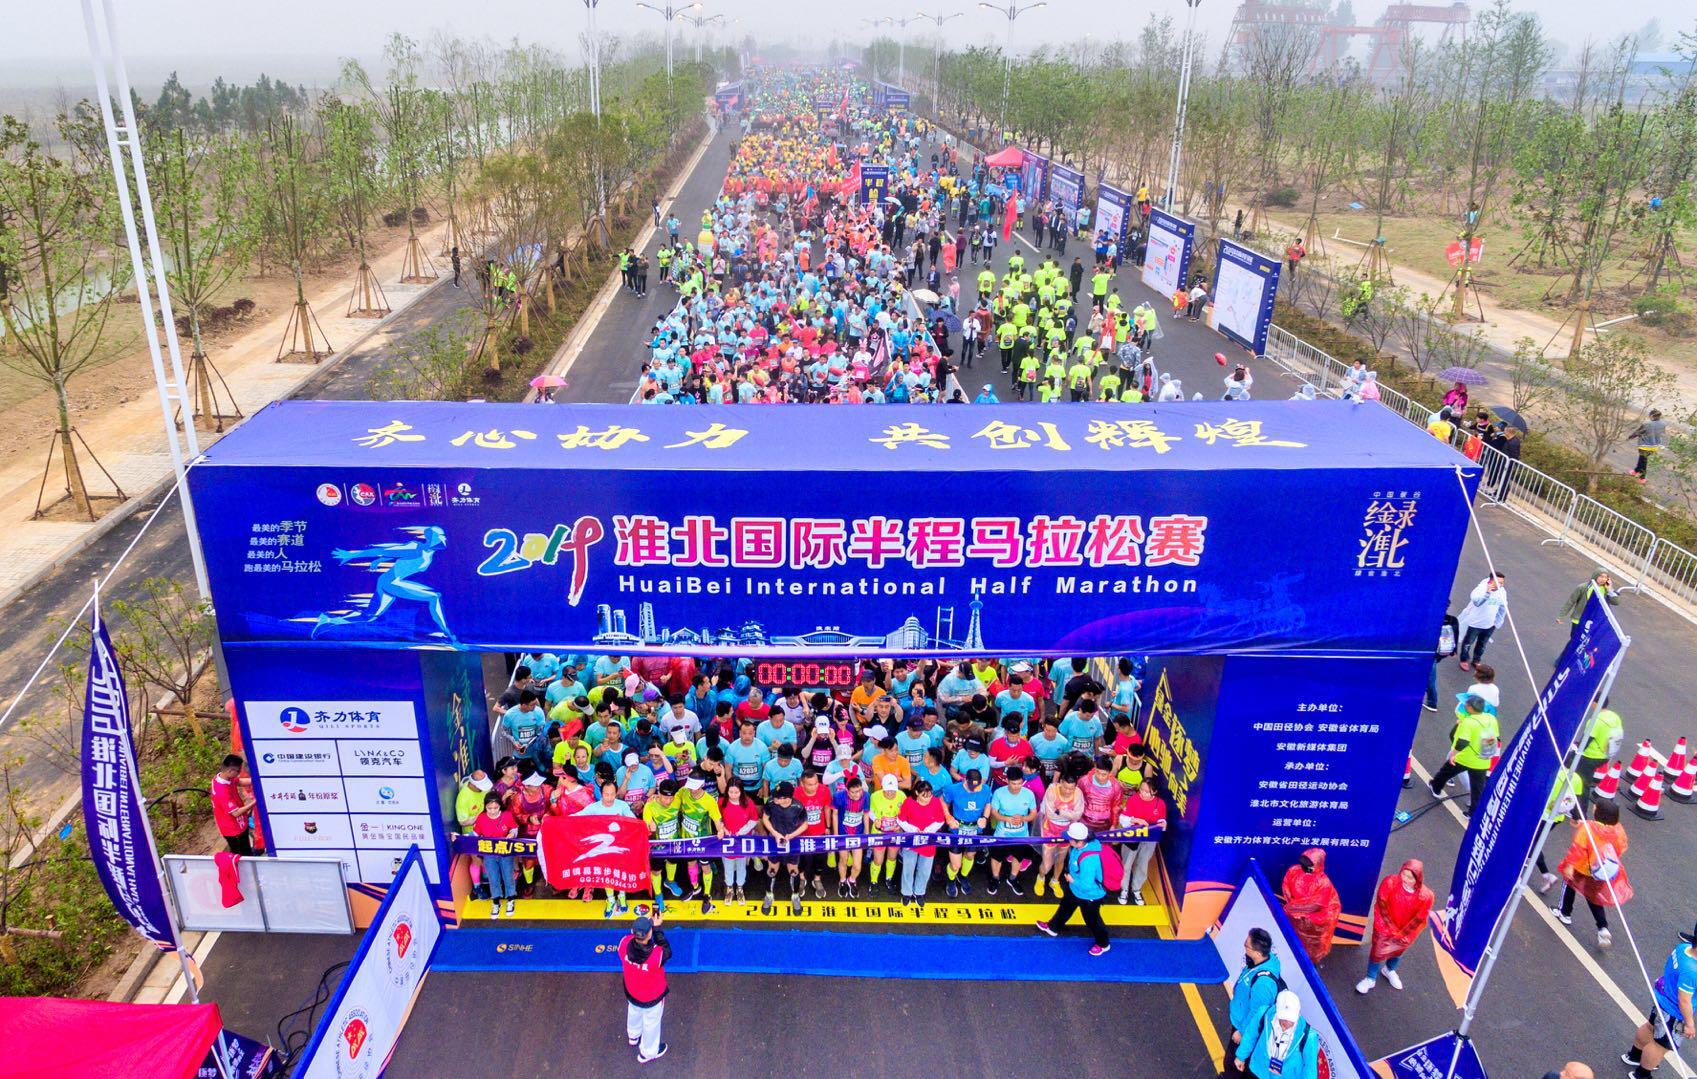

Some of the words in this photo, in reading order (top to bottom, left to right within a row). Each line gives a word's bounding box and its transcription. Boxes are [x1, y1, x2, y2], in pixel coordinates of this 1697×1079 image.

[352, 420, 749, 449] 齐心协力
[869, 417, 1308, 452] 共创辉煌
[252, 520, 307, 532] 最美的季节
[249, 534, 304, 546] 最美的赛道
[613, 514, 1207, 570] 淮北国际半程马拉松赛
[247, 548, 287, 559] 最美的人
[244, 561, 322, 573] 跑最美的马拉松
[618, 575, 732, 595] HuaiBei
[746, 577, 946, 596] International
[971, 576, 1030, 595] Half
[1056, 577, 1197, 596] Marathon
[757, 663, 851, 686] 00:00:00
[314, 711, 381, 723] 齐力体育
[1253, 723, 1313, 732] 中国田径协会
[1318, 723, 1379, 733] 安徽省体育局
[1276, 742, 1347, 752] 安徽新媒体集团
[359, 758, 402, 766] 领克汽车
[1258, 781, 1348, 791] 安徽省田径运动协会
[1250, 800, 1348, 810] 淮北市文化旅游体育局
[407, 823, 424, 831] ONE
[1213, 835, 1370, 848] 安徽齐力体育文化产业发展有限公司
